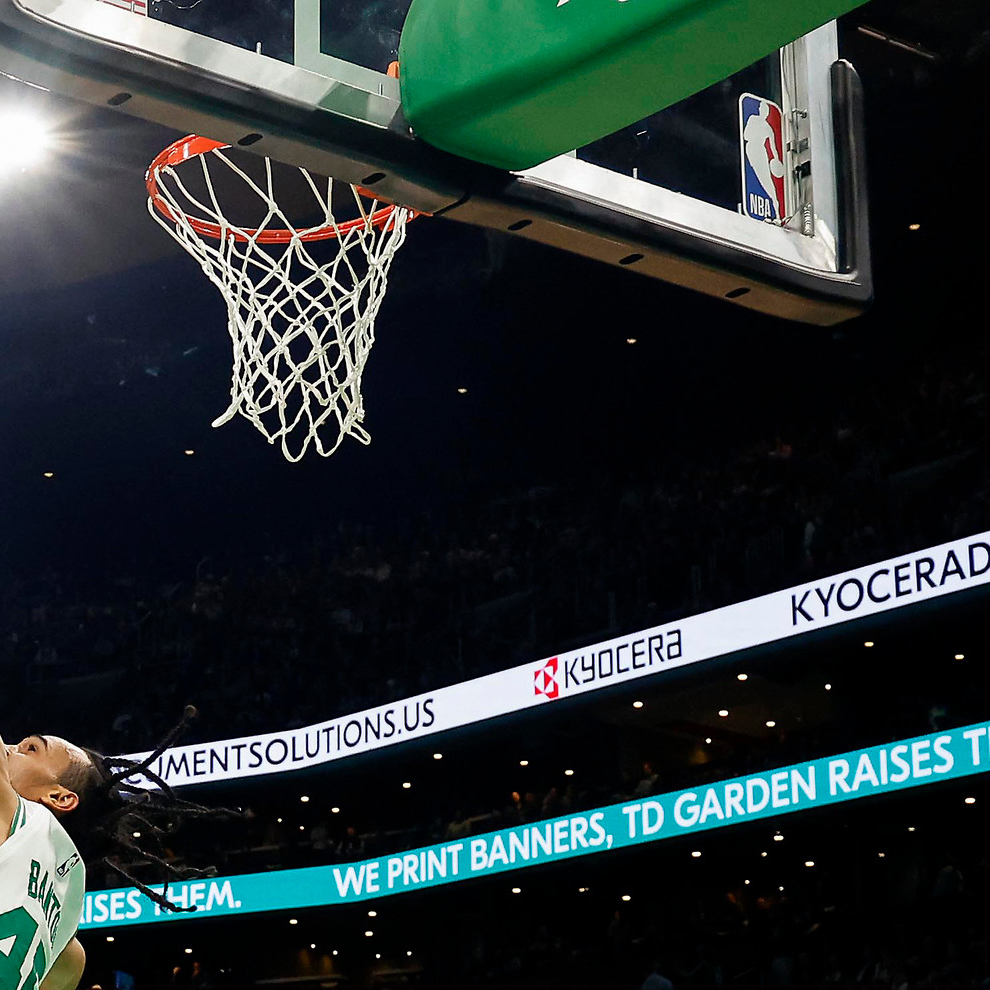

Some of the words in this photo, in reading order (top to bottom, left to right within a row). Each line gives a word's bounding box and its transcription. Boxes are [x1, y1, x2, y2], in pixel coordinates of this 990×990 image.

[750, 193, 771, 217] NBA
[563, 628, 682, 688] KYOCERA
[333, 861, 380, 898] WE
[387, 844, 463, 890] PRINT
[470, 812, 614, 871] BANNERS,
[622, 800, 665, 838] TD
[673, 765, 817, 828] GARDEN
[828, 735, 955, 796] RAISES
